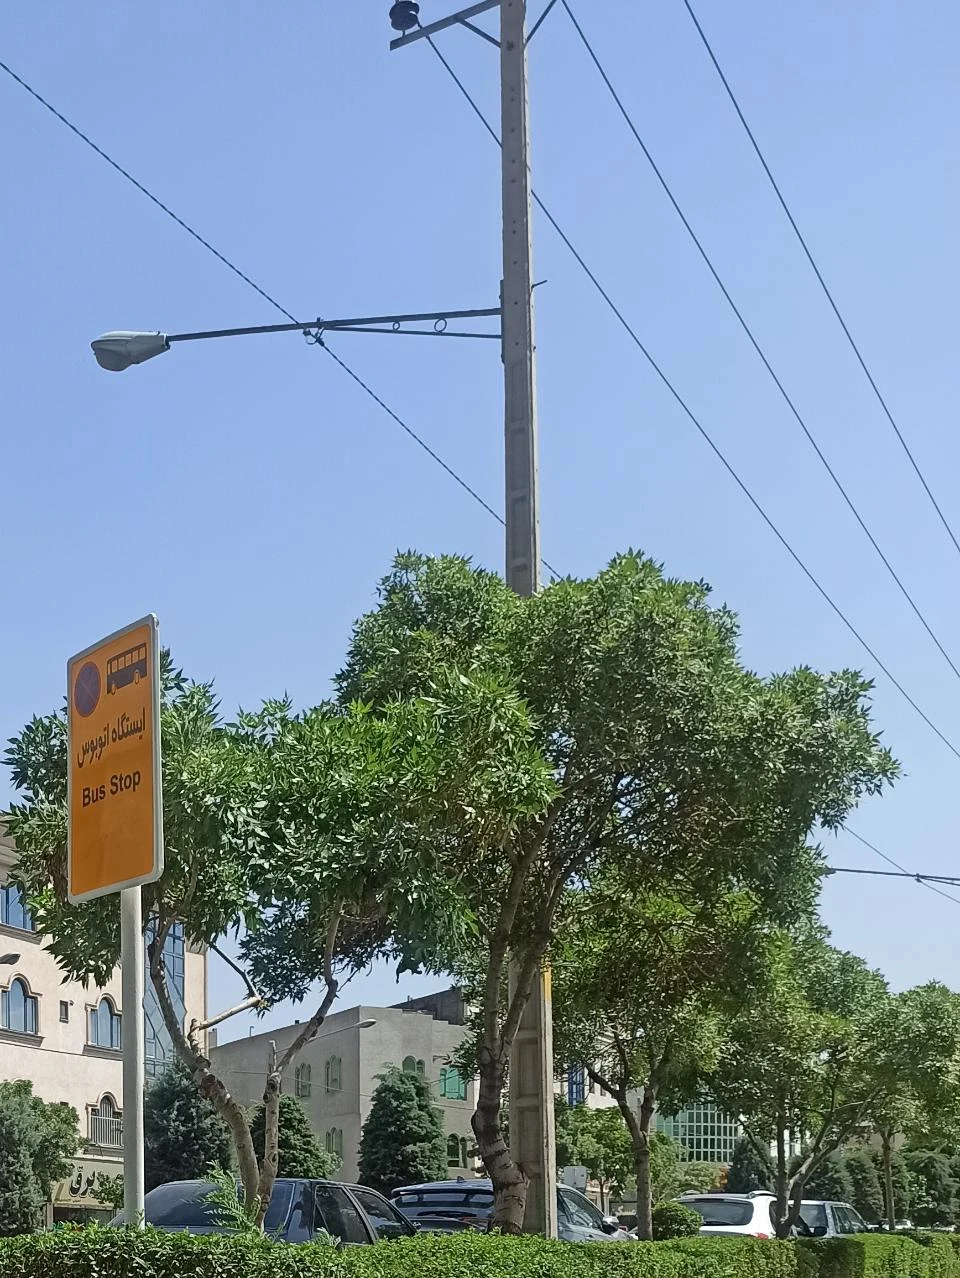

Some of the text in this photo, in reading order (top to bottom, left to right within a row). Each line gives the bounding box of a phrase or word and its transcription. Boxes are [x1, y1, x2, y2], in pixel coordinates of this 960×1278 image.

[77, 706, 146, 769] ایستگاه اتوبوس
[82, 770, 141, 808] Bus Stop
